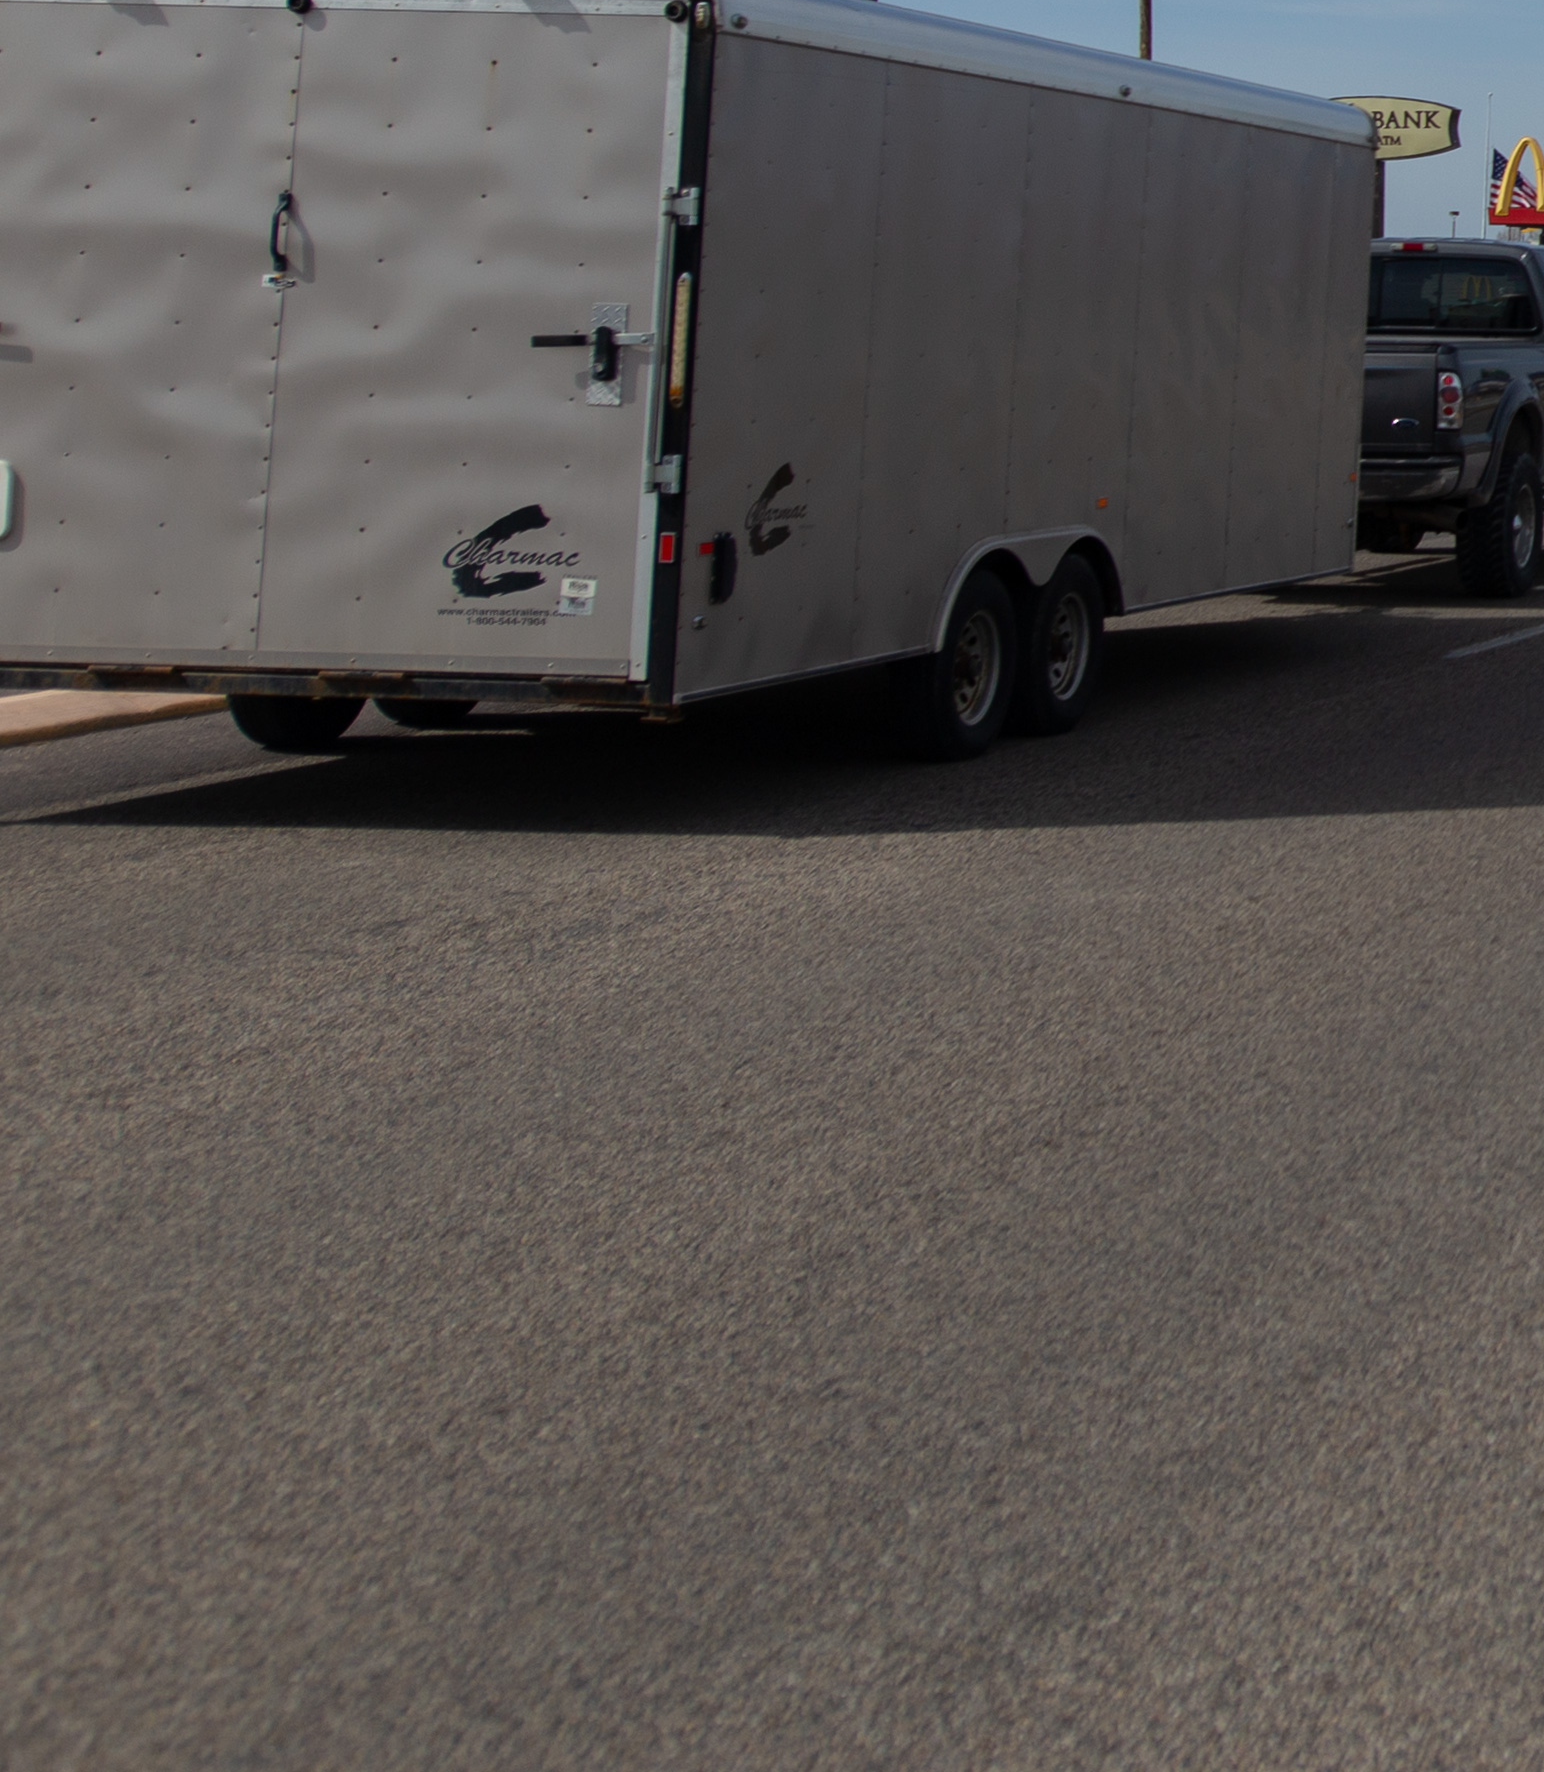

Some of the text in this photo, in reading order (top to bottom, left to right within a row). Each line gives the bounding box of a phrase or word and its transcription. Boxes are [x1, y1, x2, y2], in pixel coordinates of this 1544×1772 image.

[1373, 111, 1441, 129] BANK
[1377, 135, 1402, 146] ATM
[442, 537, 581, 571] Charmac
